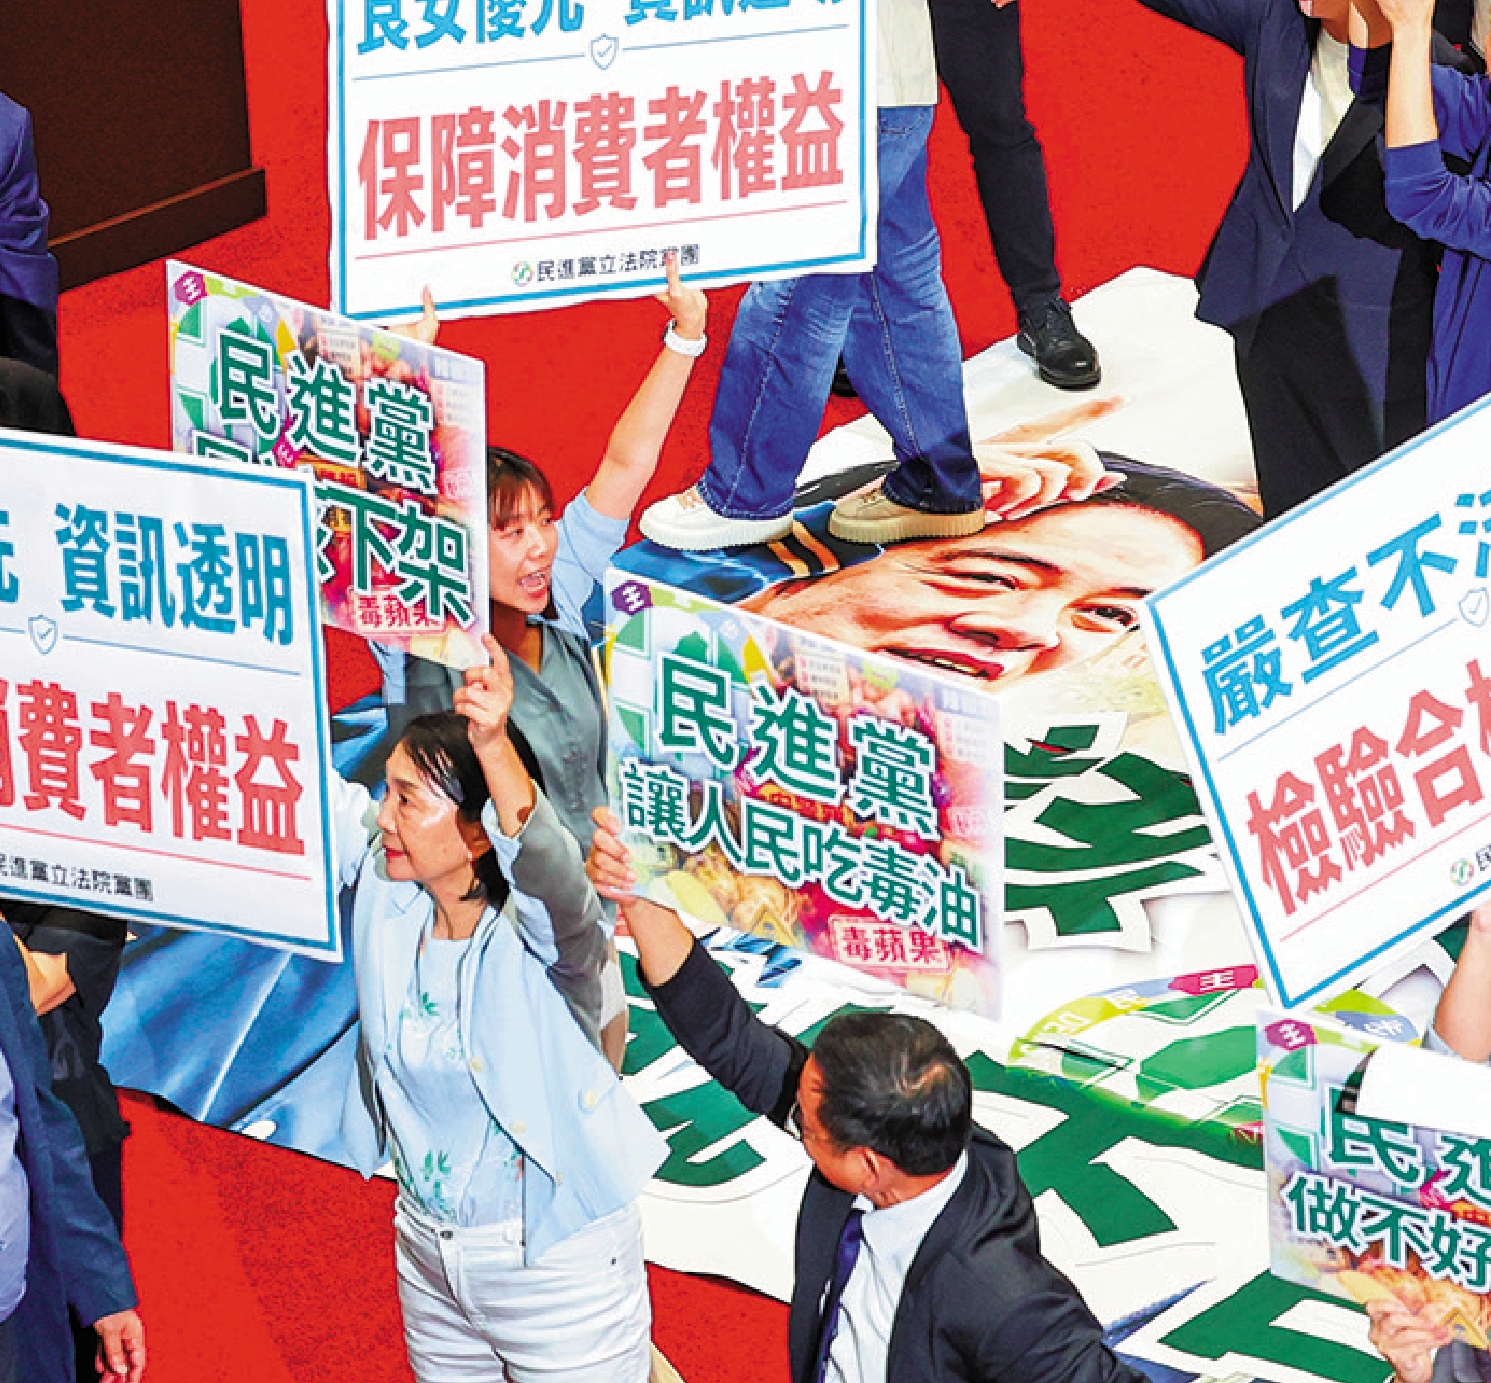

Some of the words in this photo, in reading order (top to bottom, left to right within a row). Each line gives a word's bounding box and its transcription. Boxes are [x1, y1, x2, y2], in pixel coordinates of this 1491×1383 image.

[357, 71, 845, 241] 保障消費者權益
[219, 331, 436, 492] 民進黨
[56, 503, 292, 647] 資訊透明
[196, 434, 475, 628] 下架
[661, 656, 940, 841] 民進黨
[622, 758, 982, 949] 讓人民吃毒油
[841, 927, 941, 963] 毒蘋果
